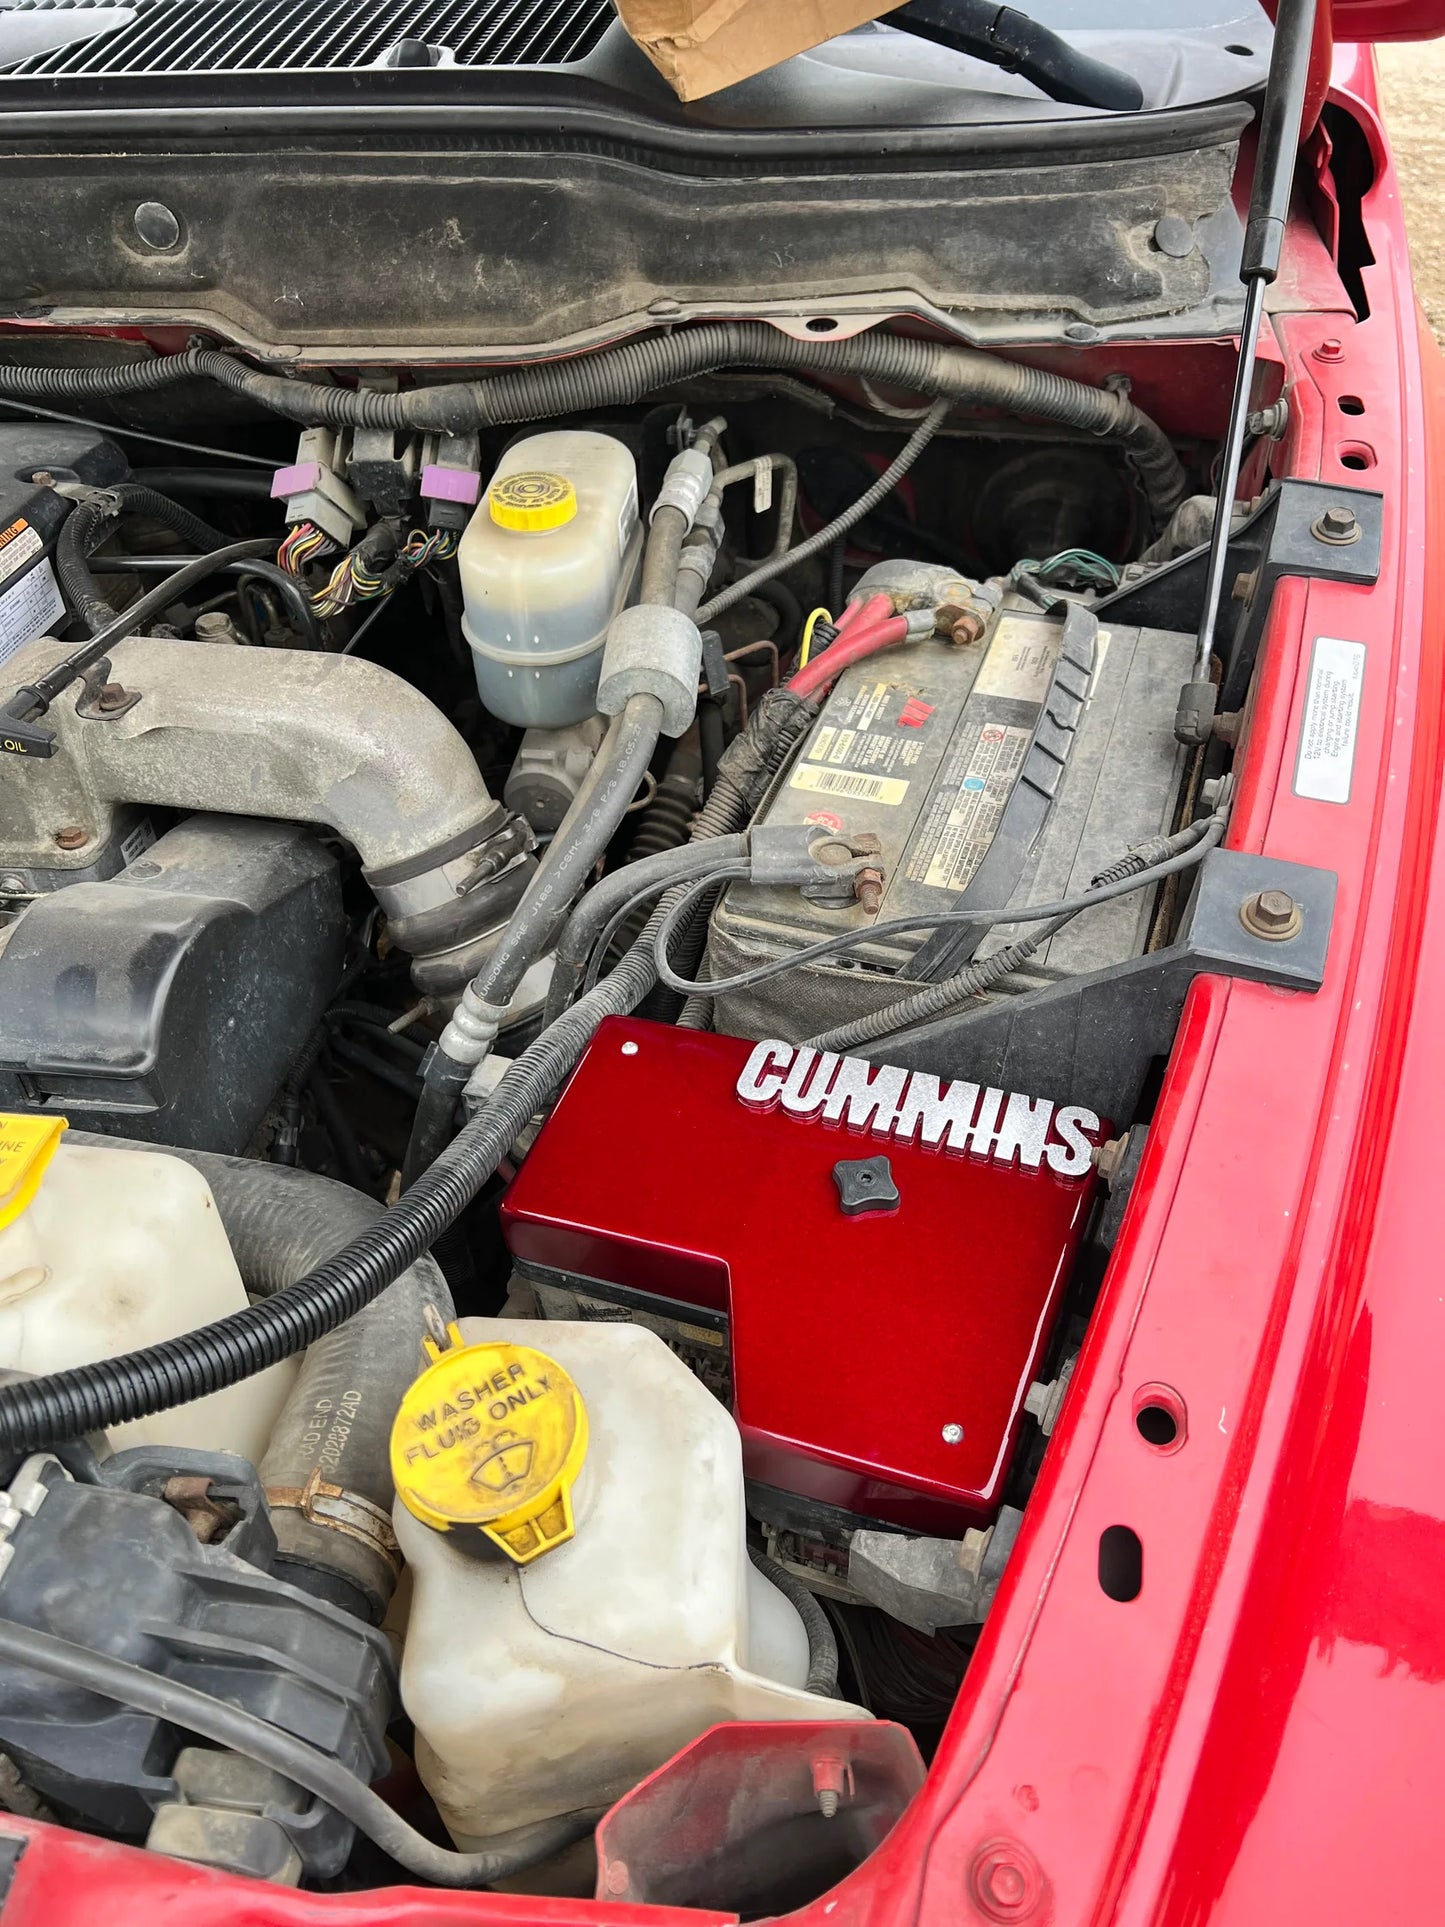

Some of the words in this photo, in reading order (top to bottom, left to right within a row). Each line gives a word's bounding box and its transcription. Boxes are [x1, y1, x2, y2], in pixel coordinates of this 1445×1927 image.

[0, 526, 19, 548] NING
[1316, 668, 1324, 691] nominal
[1324, 670, 1334, 689] during
[1321, 688, 1329, 711] system
[1311, 704, 1319, 721] more
[1309, 722, 1318, 738] apply
[1317, 711, 1327, 738] electrical
[1324, 728, 1334, 755] charging
[1329, 704, 1337, 720] jump
[1330, 737, 1341, 758] Engine
[1336, 700, 1346, 724] starting
[4, 739, 28, 753] OIL
[1307, 738, 1315, 750] not
[1316, 738, 1323, 746] to
[1341, 727, 1350, 747] failure
[1304, 750, 1312, 760] Do
[1313, 744, 1322, 760] 12V
[511, 921, 529, 947] SAE
[582, 808, 601, 833] 3/8
[600, 779, 617, 803] P/S
[736, 1038, 1100, 1177] CUMMINS
[412, 1362, 526, 1432] WASHER
[488, 1374, 553, 1421] ONLY
[308, 1398, 333, 1429] END
